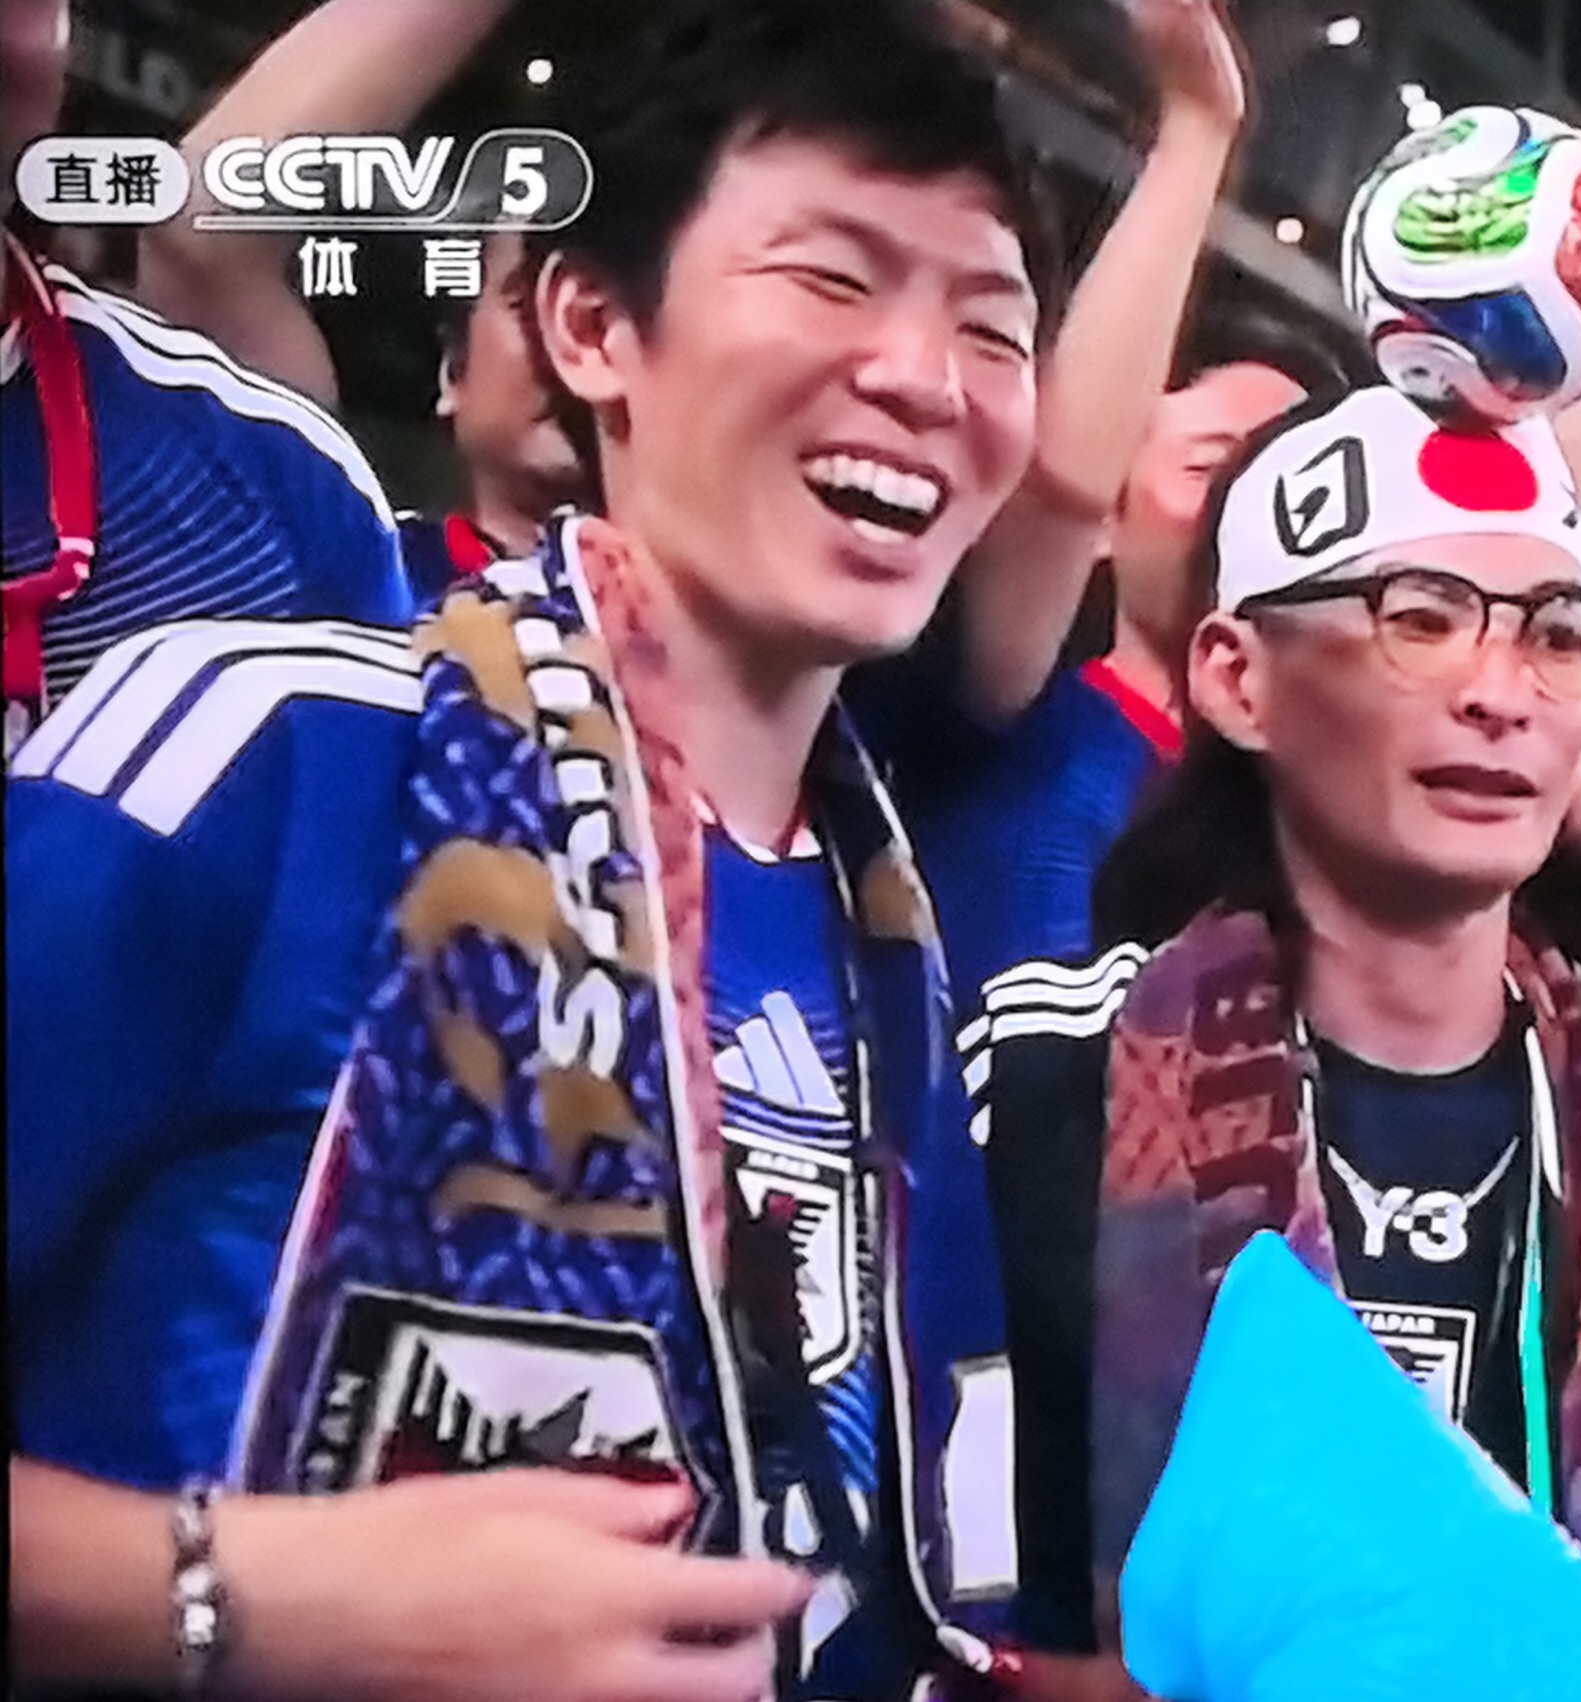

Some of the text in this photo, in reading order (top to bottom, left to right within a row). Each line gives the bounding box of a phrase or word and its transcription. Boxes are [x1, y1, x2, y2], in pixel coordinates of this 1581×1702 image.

[46, 153, 160, 206] 直播
[203, 137, 548, 215] CCTV 5
[299, 238, 482, 296] 体育
